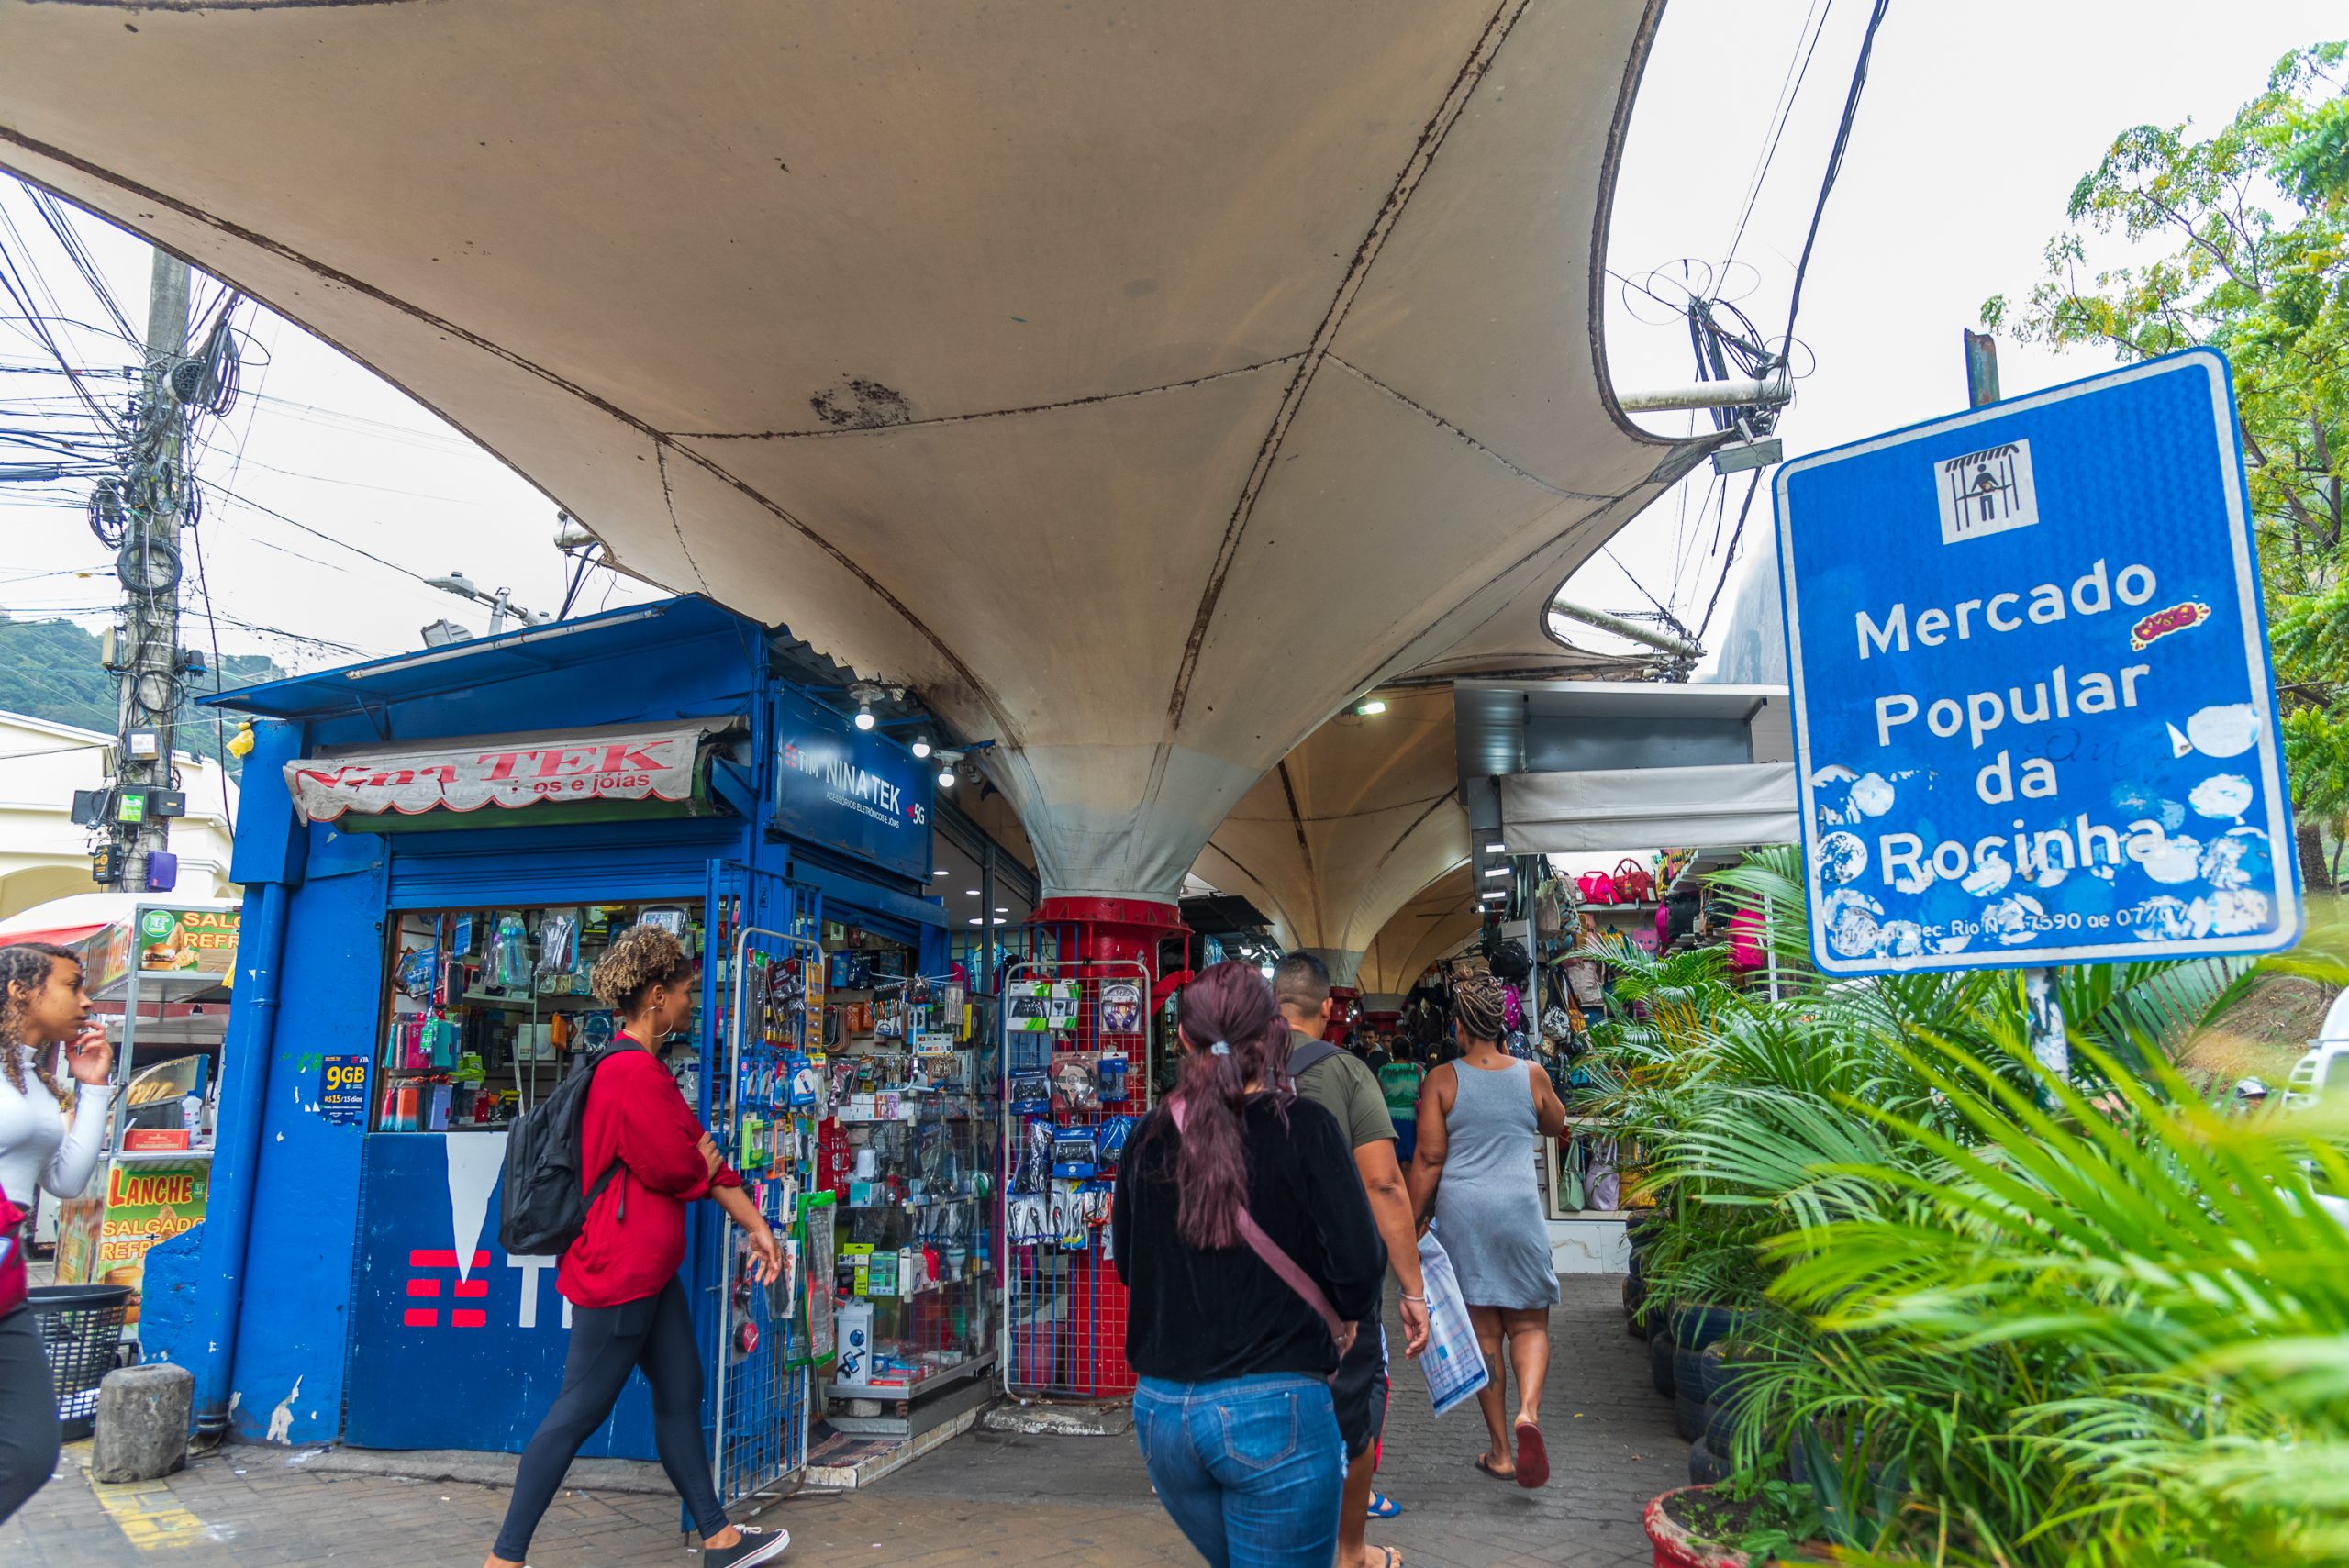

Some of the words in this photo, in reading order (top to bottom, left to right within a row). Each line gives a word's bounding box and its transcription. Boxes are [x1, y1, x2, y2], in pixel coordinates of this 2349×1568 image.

[1855, 558, 2156, 660] Mercado
[1875, 664, 2150, 750] Popular
[477, 740, 674, 784] TEK
[570, 778, 584, 792] e
[591, 772, 651, 795] jóias
[1976, 750, 2058, 805] da
[797, 750, 818, 779] TIM
[826, 756, 868, 800] NINA
[871, 774, 901, 816] TEK
[912, 803, 925, 826] 5G
[827, 790, 857, 811] ACESSÓRIOS
[856, 802, 885, 824] ELETRÔNICOS
[1879, 813, 2169, 885] Rocinha
[1950, 919, 1980, 936] Rio
[327, 1066, 365, 1091] 9GB
[108, 1168, 194, 1207] LANCHE
